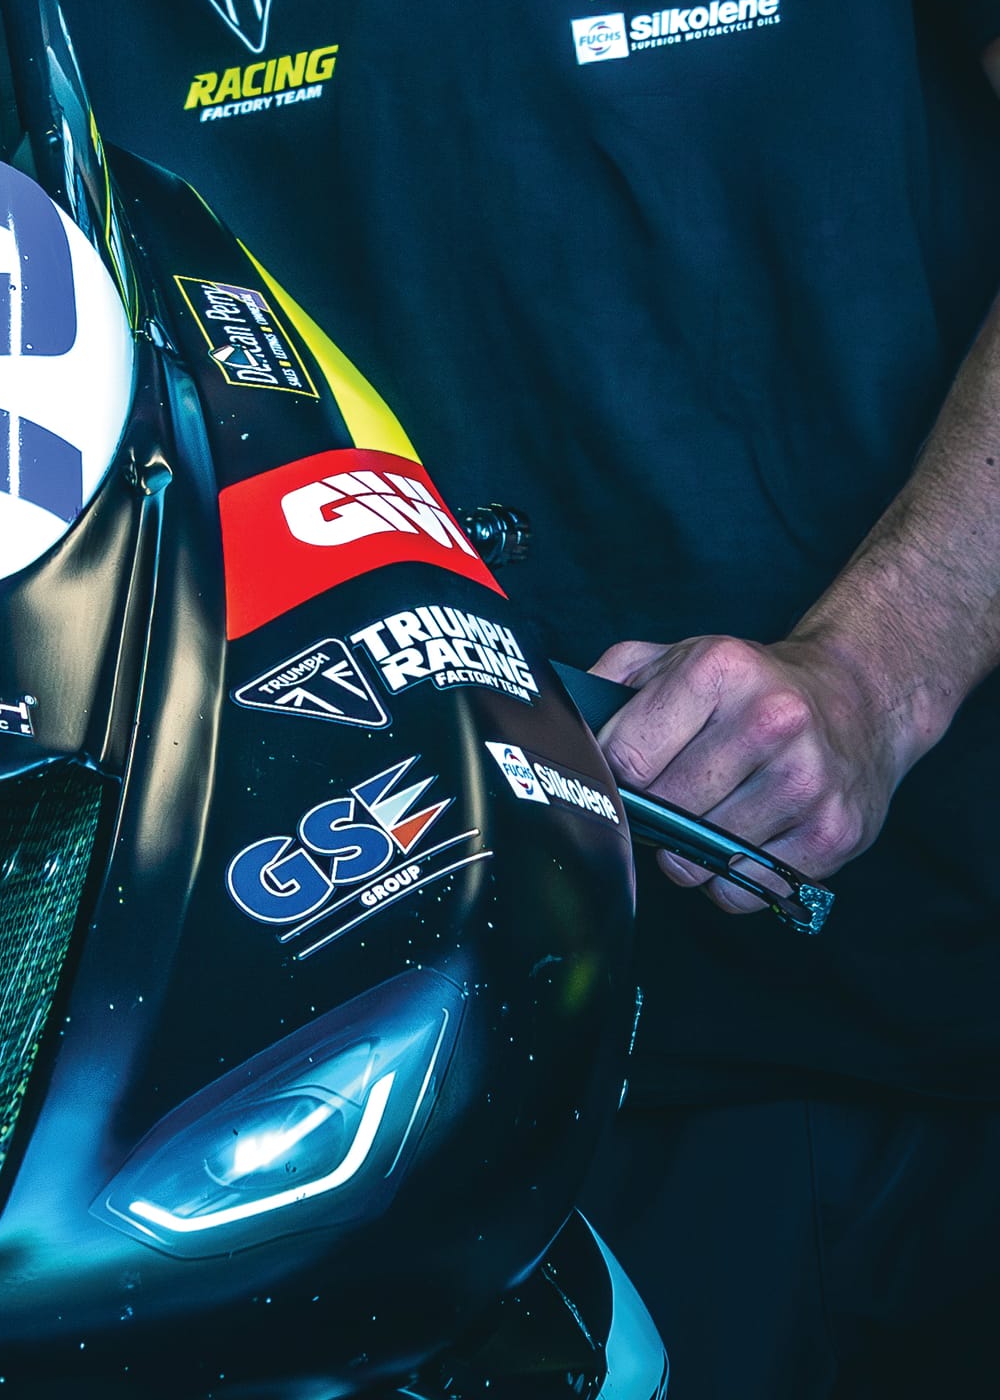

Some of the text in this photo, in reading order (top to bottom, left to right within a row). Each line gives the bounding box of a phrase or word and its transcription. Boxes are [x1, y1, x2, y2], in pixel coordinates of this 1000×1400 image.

[578, 31, 622, 47] FUCHS
[630, 13, 782, 52] SUPERIOR MOTORCYCLE OILS
[184, 45, 339, 110] RACING
[200, 84, 323, 122] FACTORY TEAM
[263, 332, 288, 360] LETTINGS
[282, 367, 302, 388] SALES
[280, 469, 479, 560] GIVI
[350, 605, 525, 662] TRIUMPH
[258, 651, 331, 696] TRIUMPH
[381, 638, 540, 694] RACING
[434, 669, 532, 701] FACTORY TEAM
[502, 762, 620, 825] FUCHS Silkolene
[360, 864, 422, 907] GROUP
